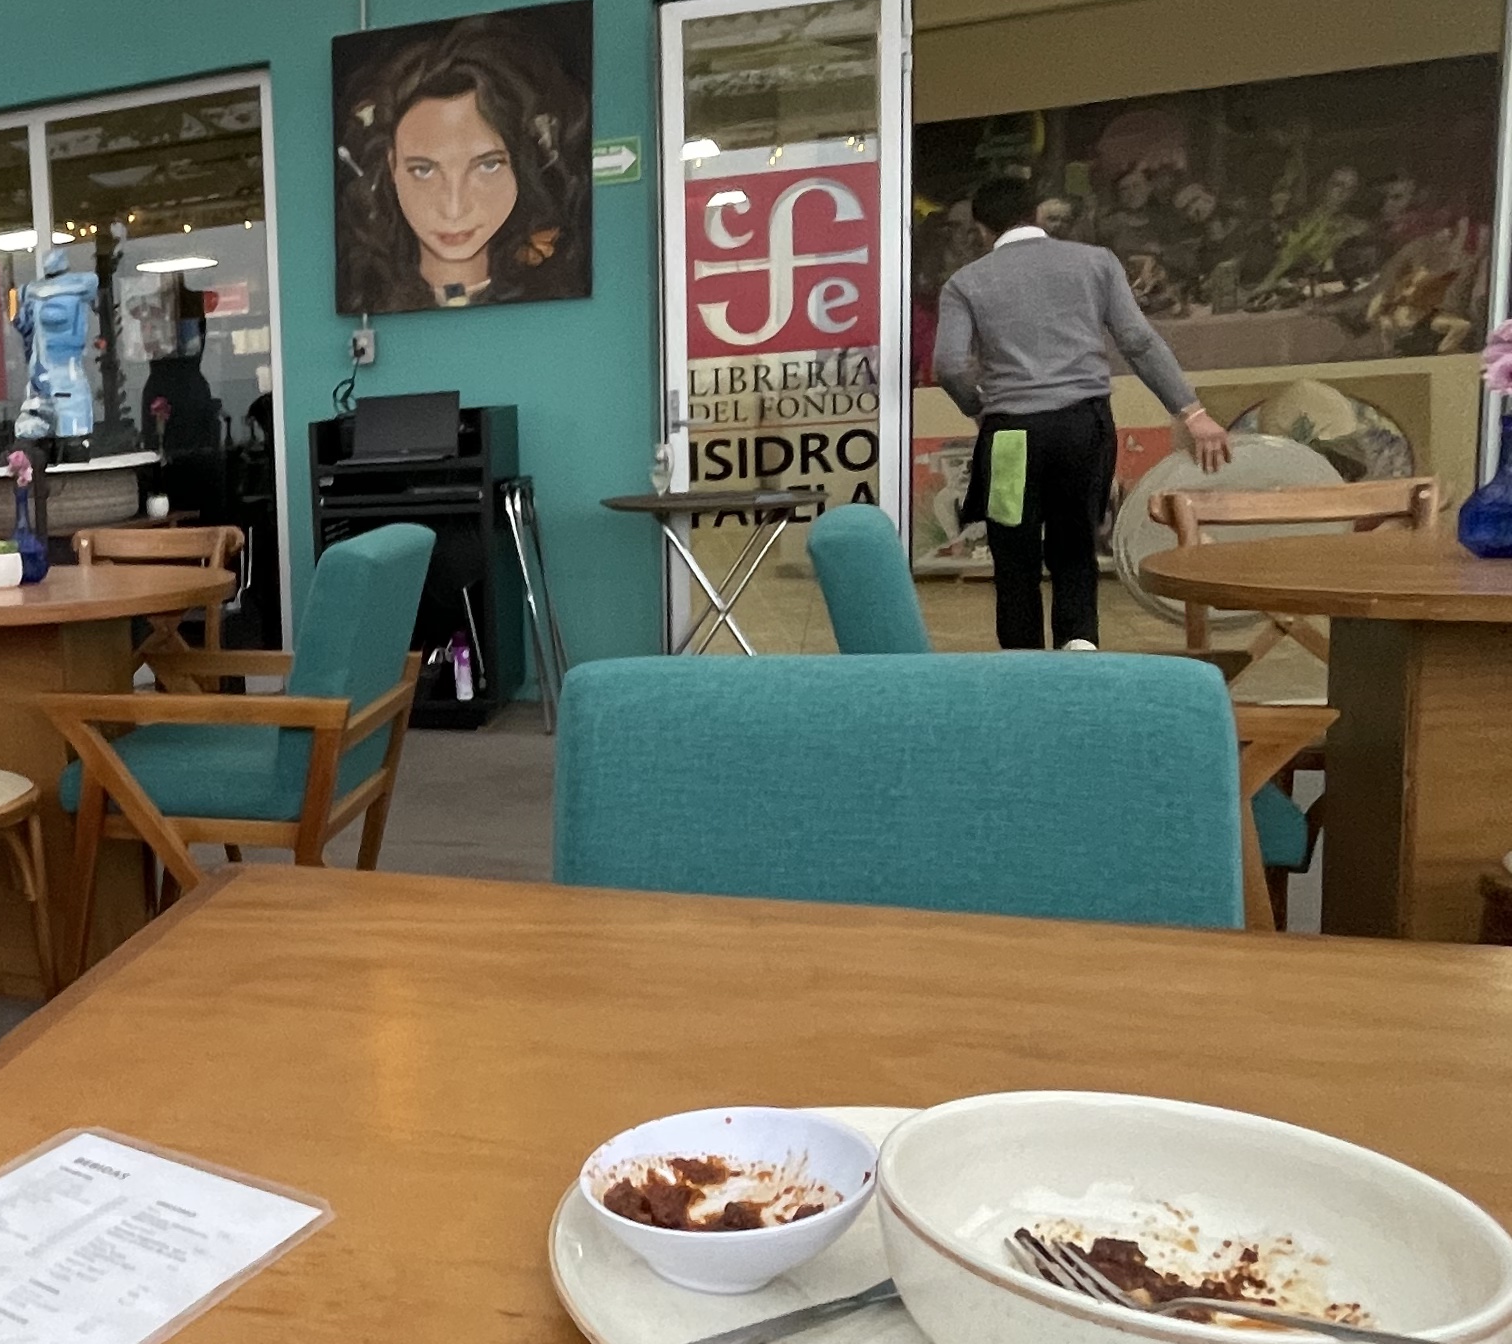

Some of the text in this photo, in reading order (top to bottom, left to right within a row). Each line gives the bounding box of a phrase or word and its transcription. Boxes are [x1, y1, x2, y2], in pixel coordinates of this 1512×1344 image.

[689, 351, 878, 399] LIBRERÍA
[689, 392, 880, 424] DEL FONDO
[689, 428, 880, 483] ISIDRO
